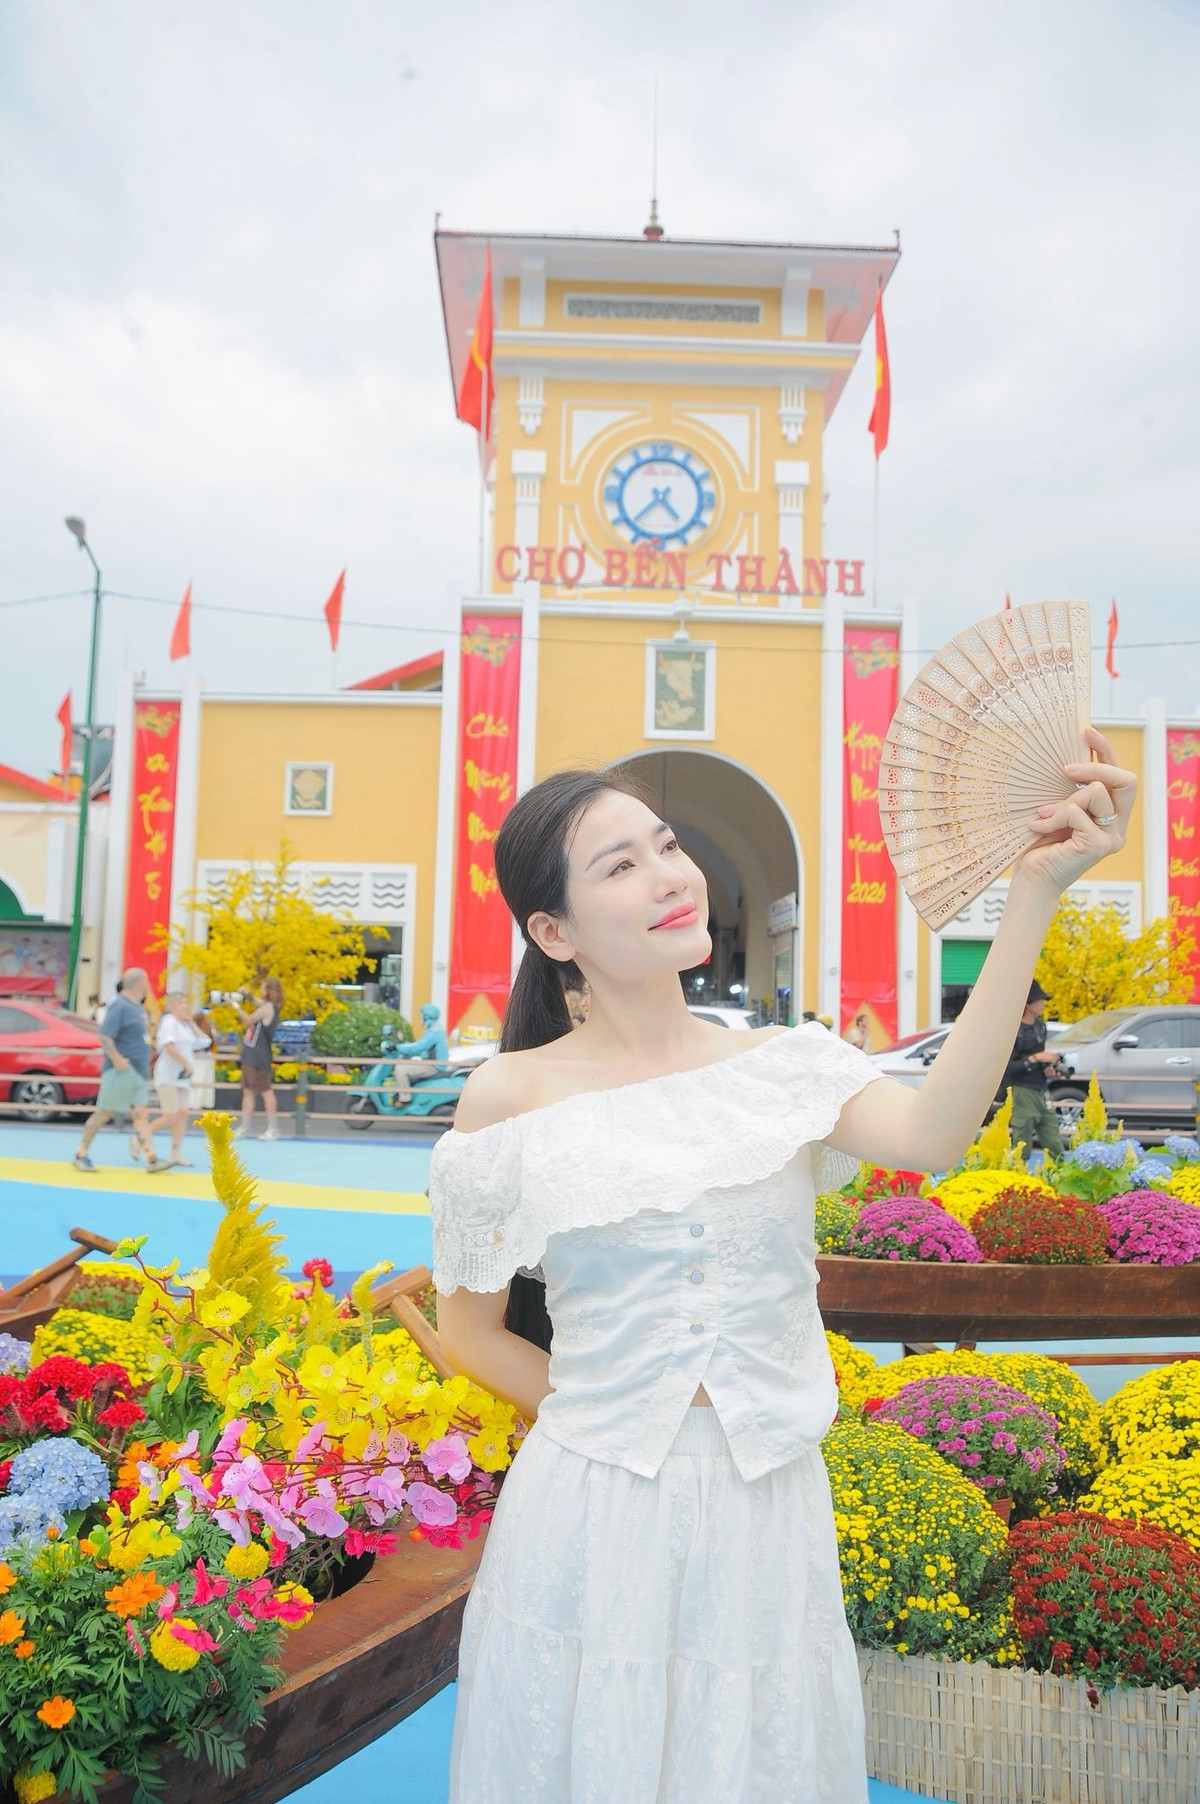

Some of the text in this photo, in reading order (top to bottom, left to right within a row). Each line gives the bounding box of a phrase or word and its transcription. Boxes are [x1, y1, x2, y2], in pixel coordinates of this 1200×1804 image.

[495, 536, 865, 596] CHỢ BẾN THÀNH
[846, 881, 887, 904] 2026
